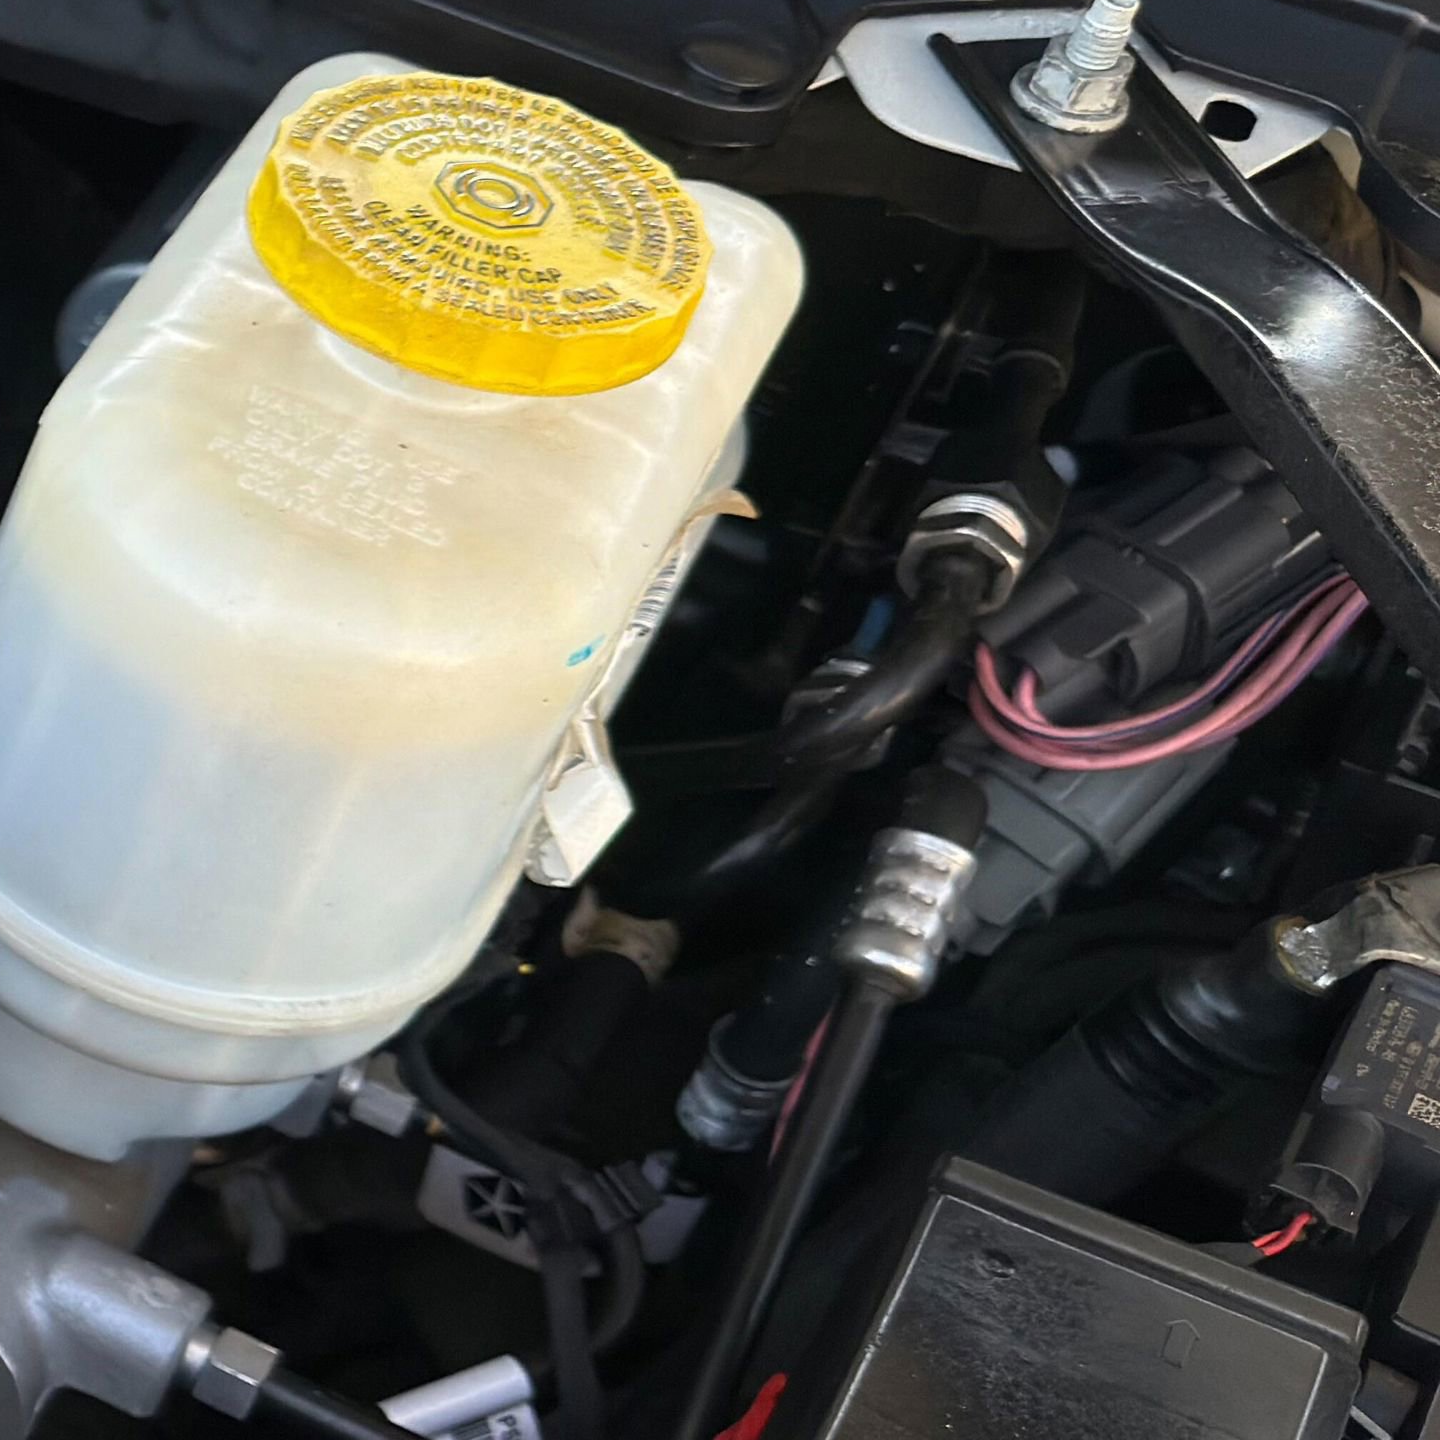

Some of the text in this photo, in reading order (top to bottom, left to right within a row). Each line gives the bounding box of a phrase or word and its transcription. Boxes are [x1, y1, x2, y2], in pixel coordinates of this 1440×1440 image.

[362, 199, 563, 285] CLEAN FILLER CAP
[508, 287, 558, 305] USE
